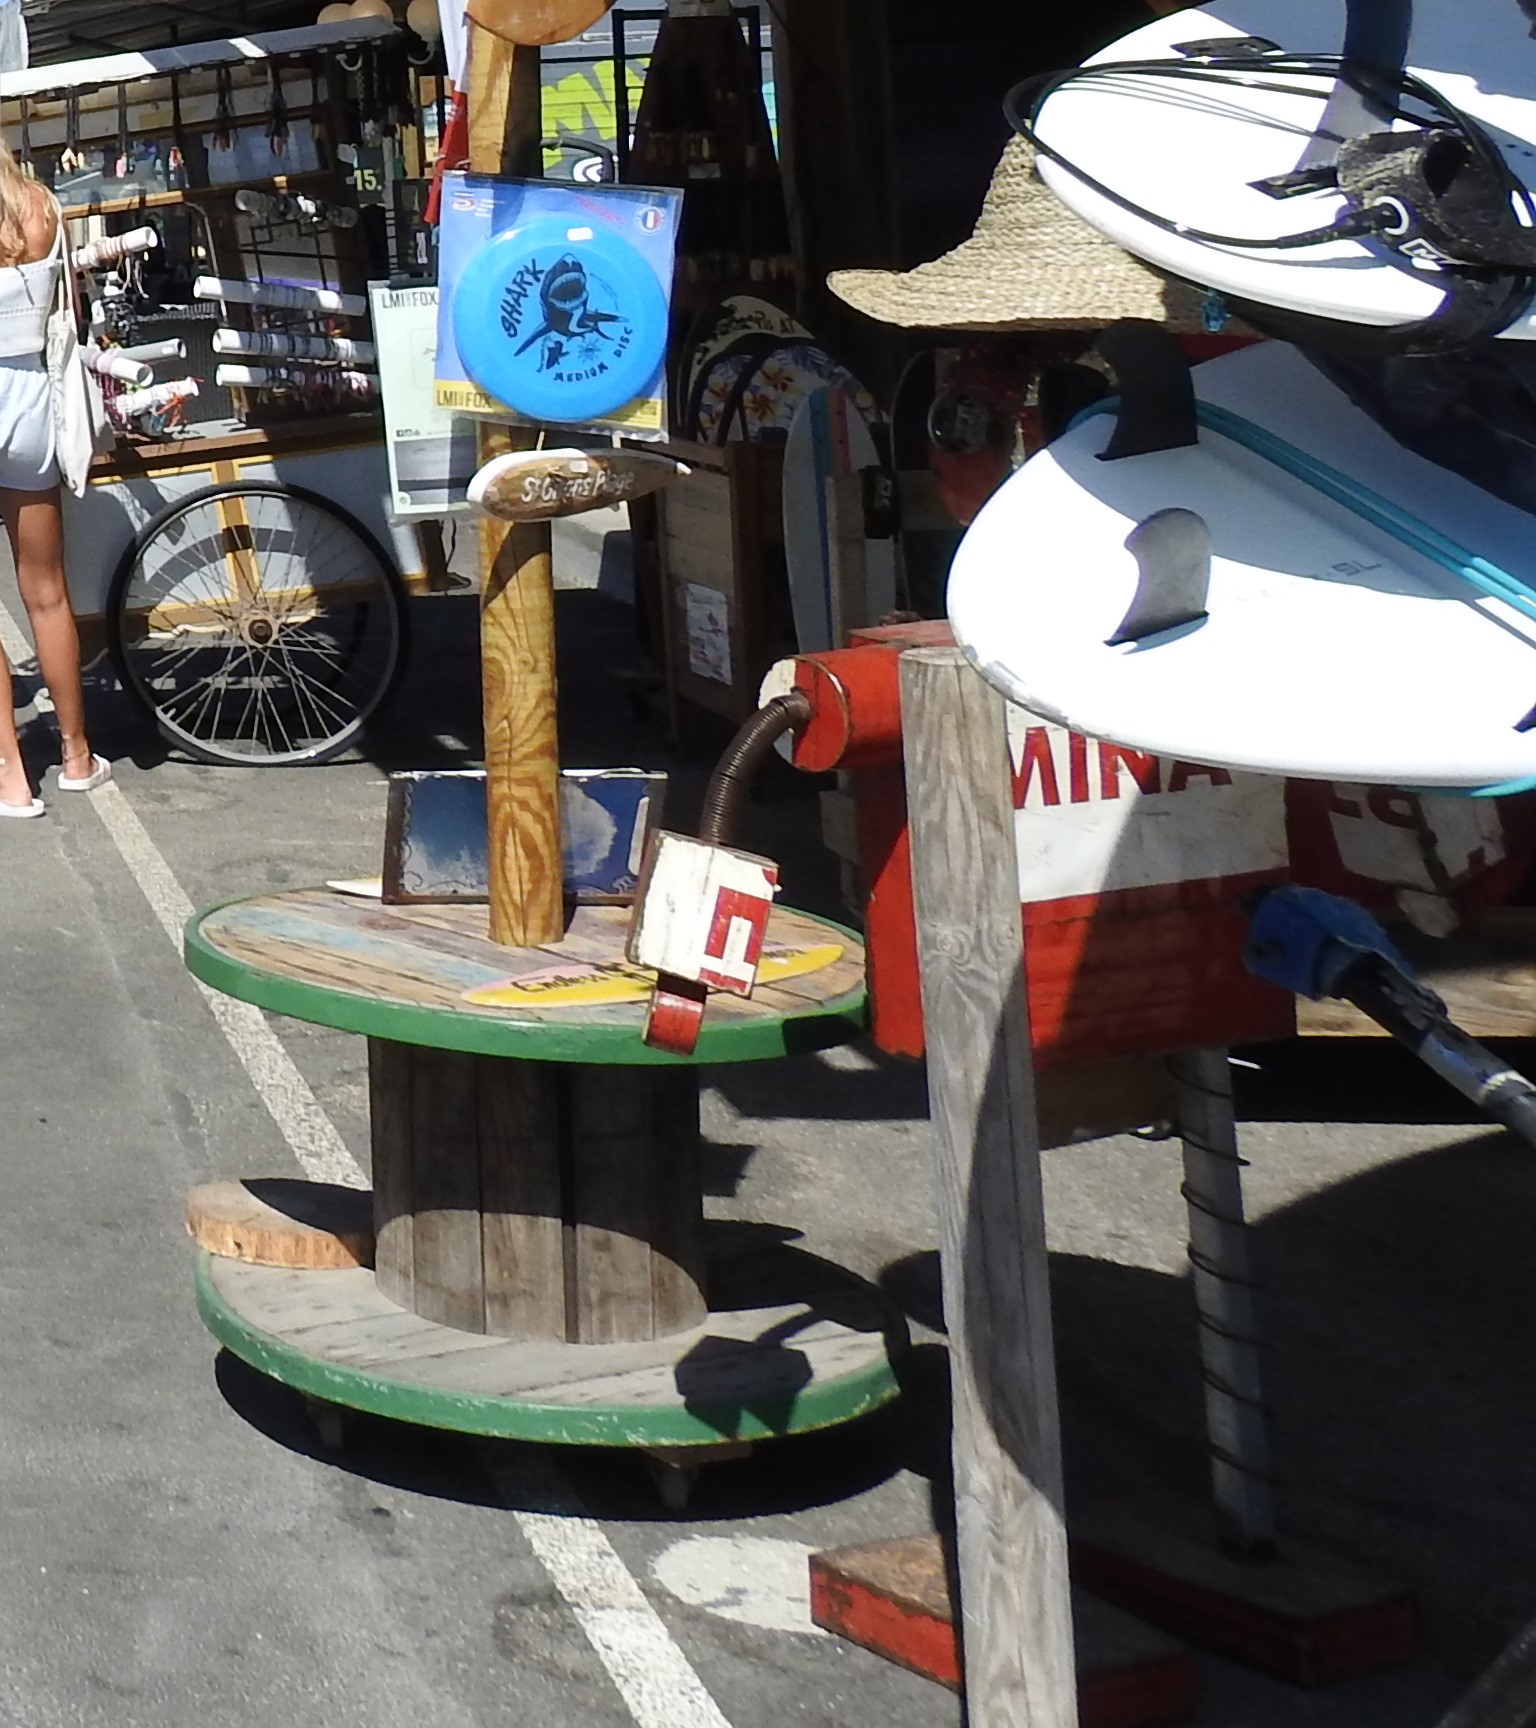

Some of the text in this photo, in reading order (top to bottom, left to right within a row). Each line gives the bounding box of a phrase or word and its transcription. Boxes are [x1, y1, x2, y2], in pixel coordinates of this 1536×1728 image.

[500, 258, 545, 339] SHARK
[554, 326, 634, 383] MEDIUM DISC
